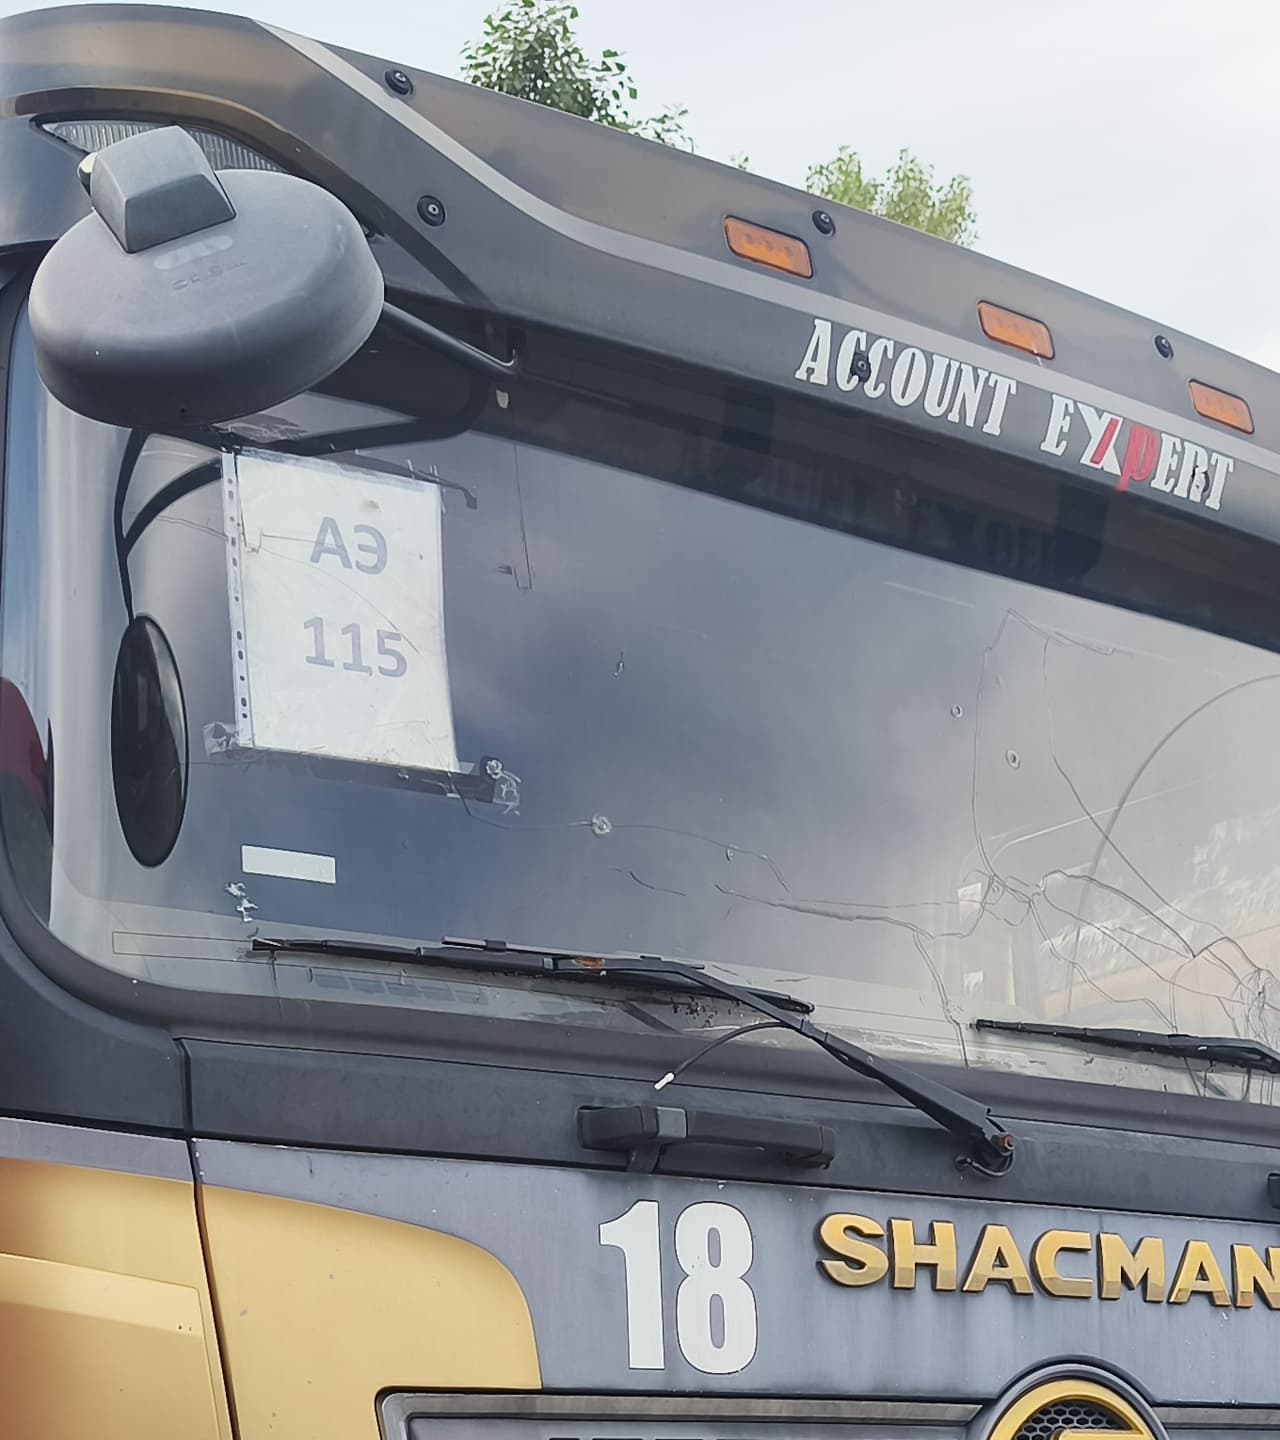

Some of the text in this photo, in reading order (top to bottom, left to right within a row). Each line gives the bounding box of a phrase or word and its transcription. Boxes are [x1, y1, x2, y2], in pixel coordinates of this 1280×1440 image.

[794, 318, 1235, 512] ACCOUNT EXPERT
[309, 515, 389, 575] АЭ
[302, 615, 409, 680] 115
[598, 1199, 758, 1375] 18
